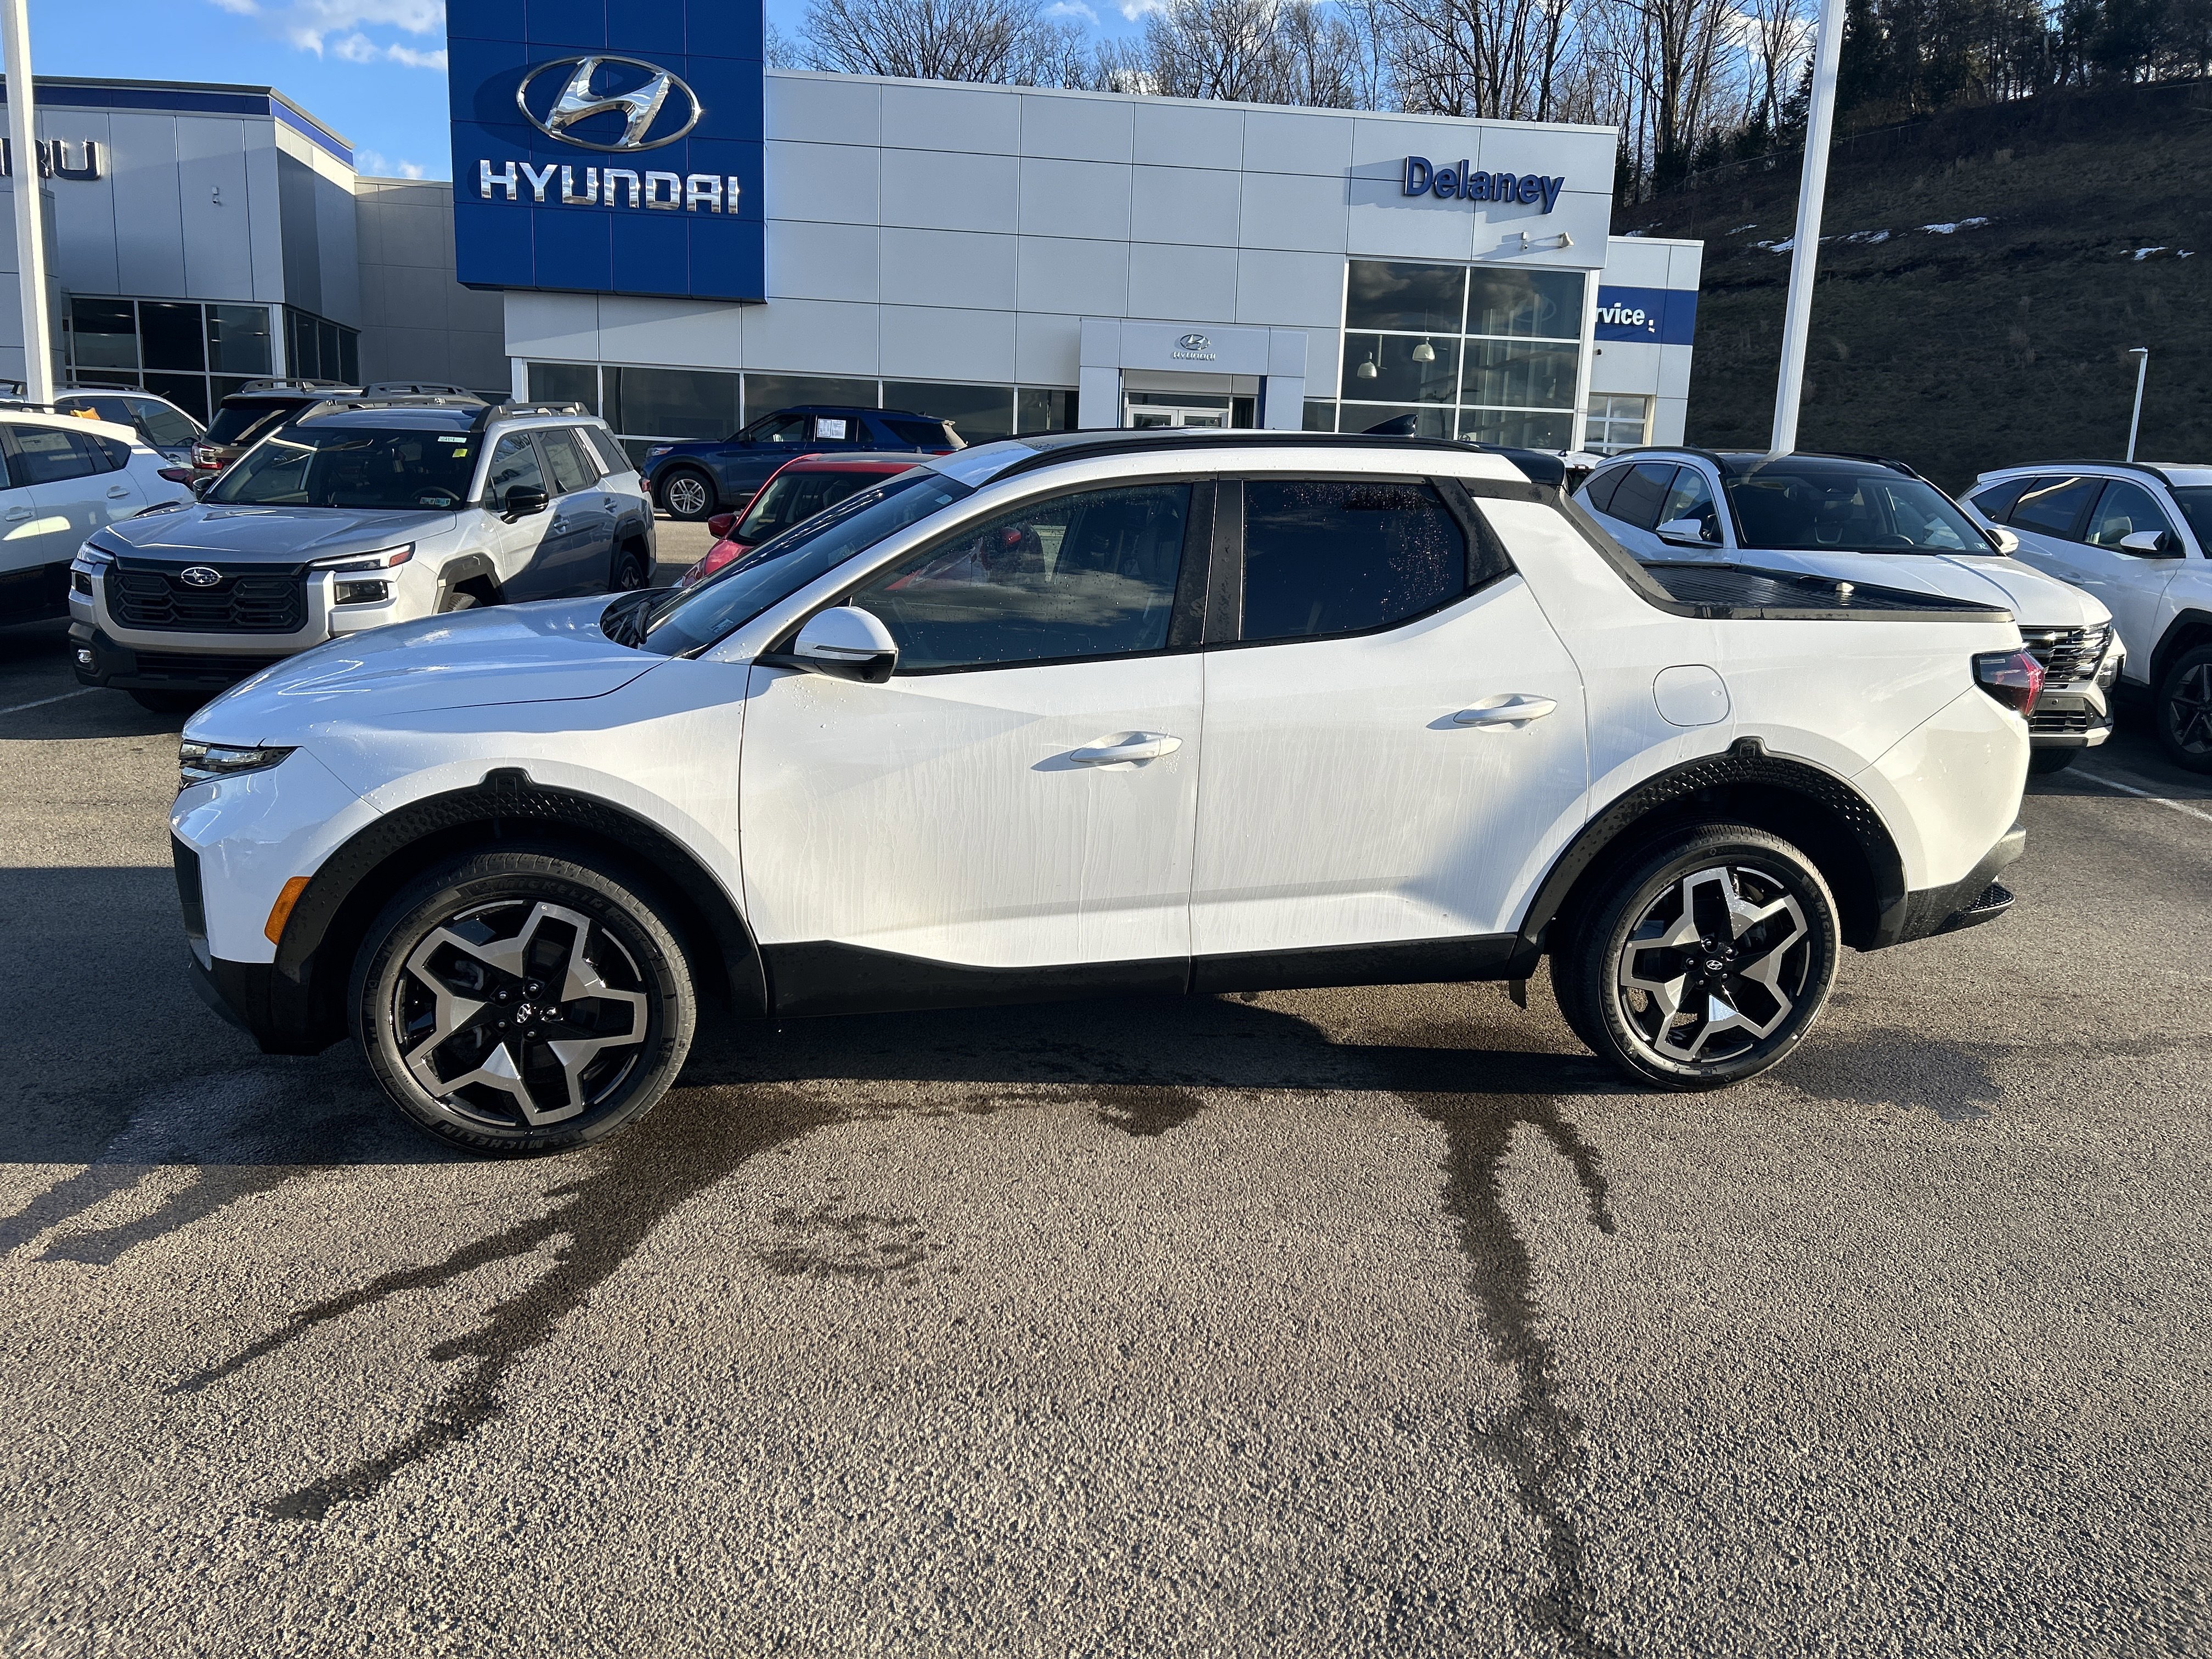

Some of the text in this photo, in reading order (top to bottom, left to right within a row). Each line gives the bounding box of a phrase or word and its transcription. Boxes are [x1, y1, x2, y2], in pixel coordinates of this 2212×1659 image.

[480, 159, 739, 215] HYUNDAI
[1404, 156, 1565, 215] Delaney
[1172, 351, 1216, 361] HYUNDAI
[496, 878, 603, 909] MICHELIN
[1815, 900, 1833, 983] MICHELIN
[439, 1124, 545, 1151] MICHELIN
